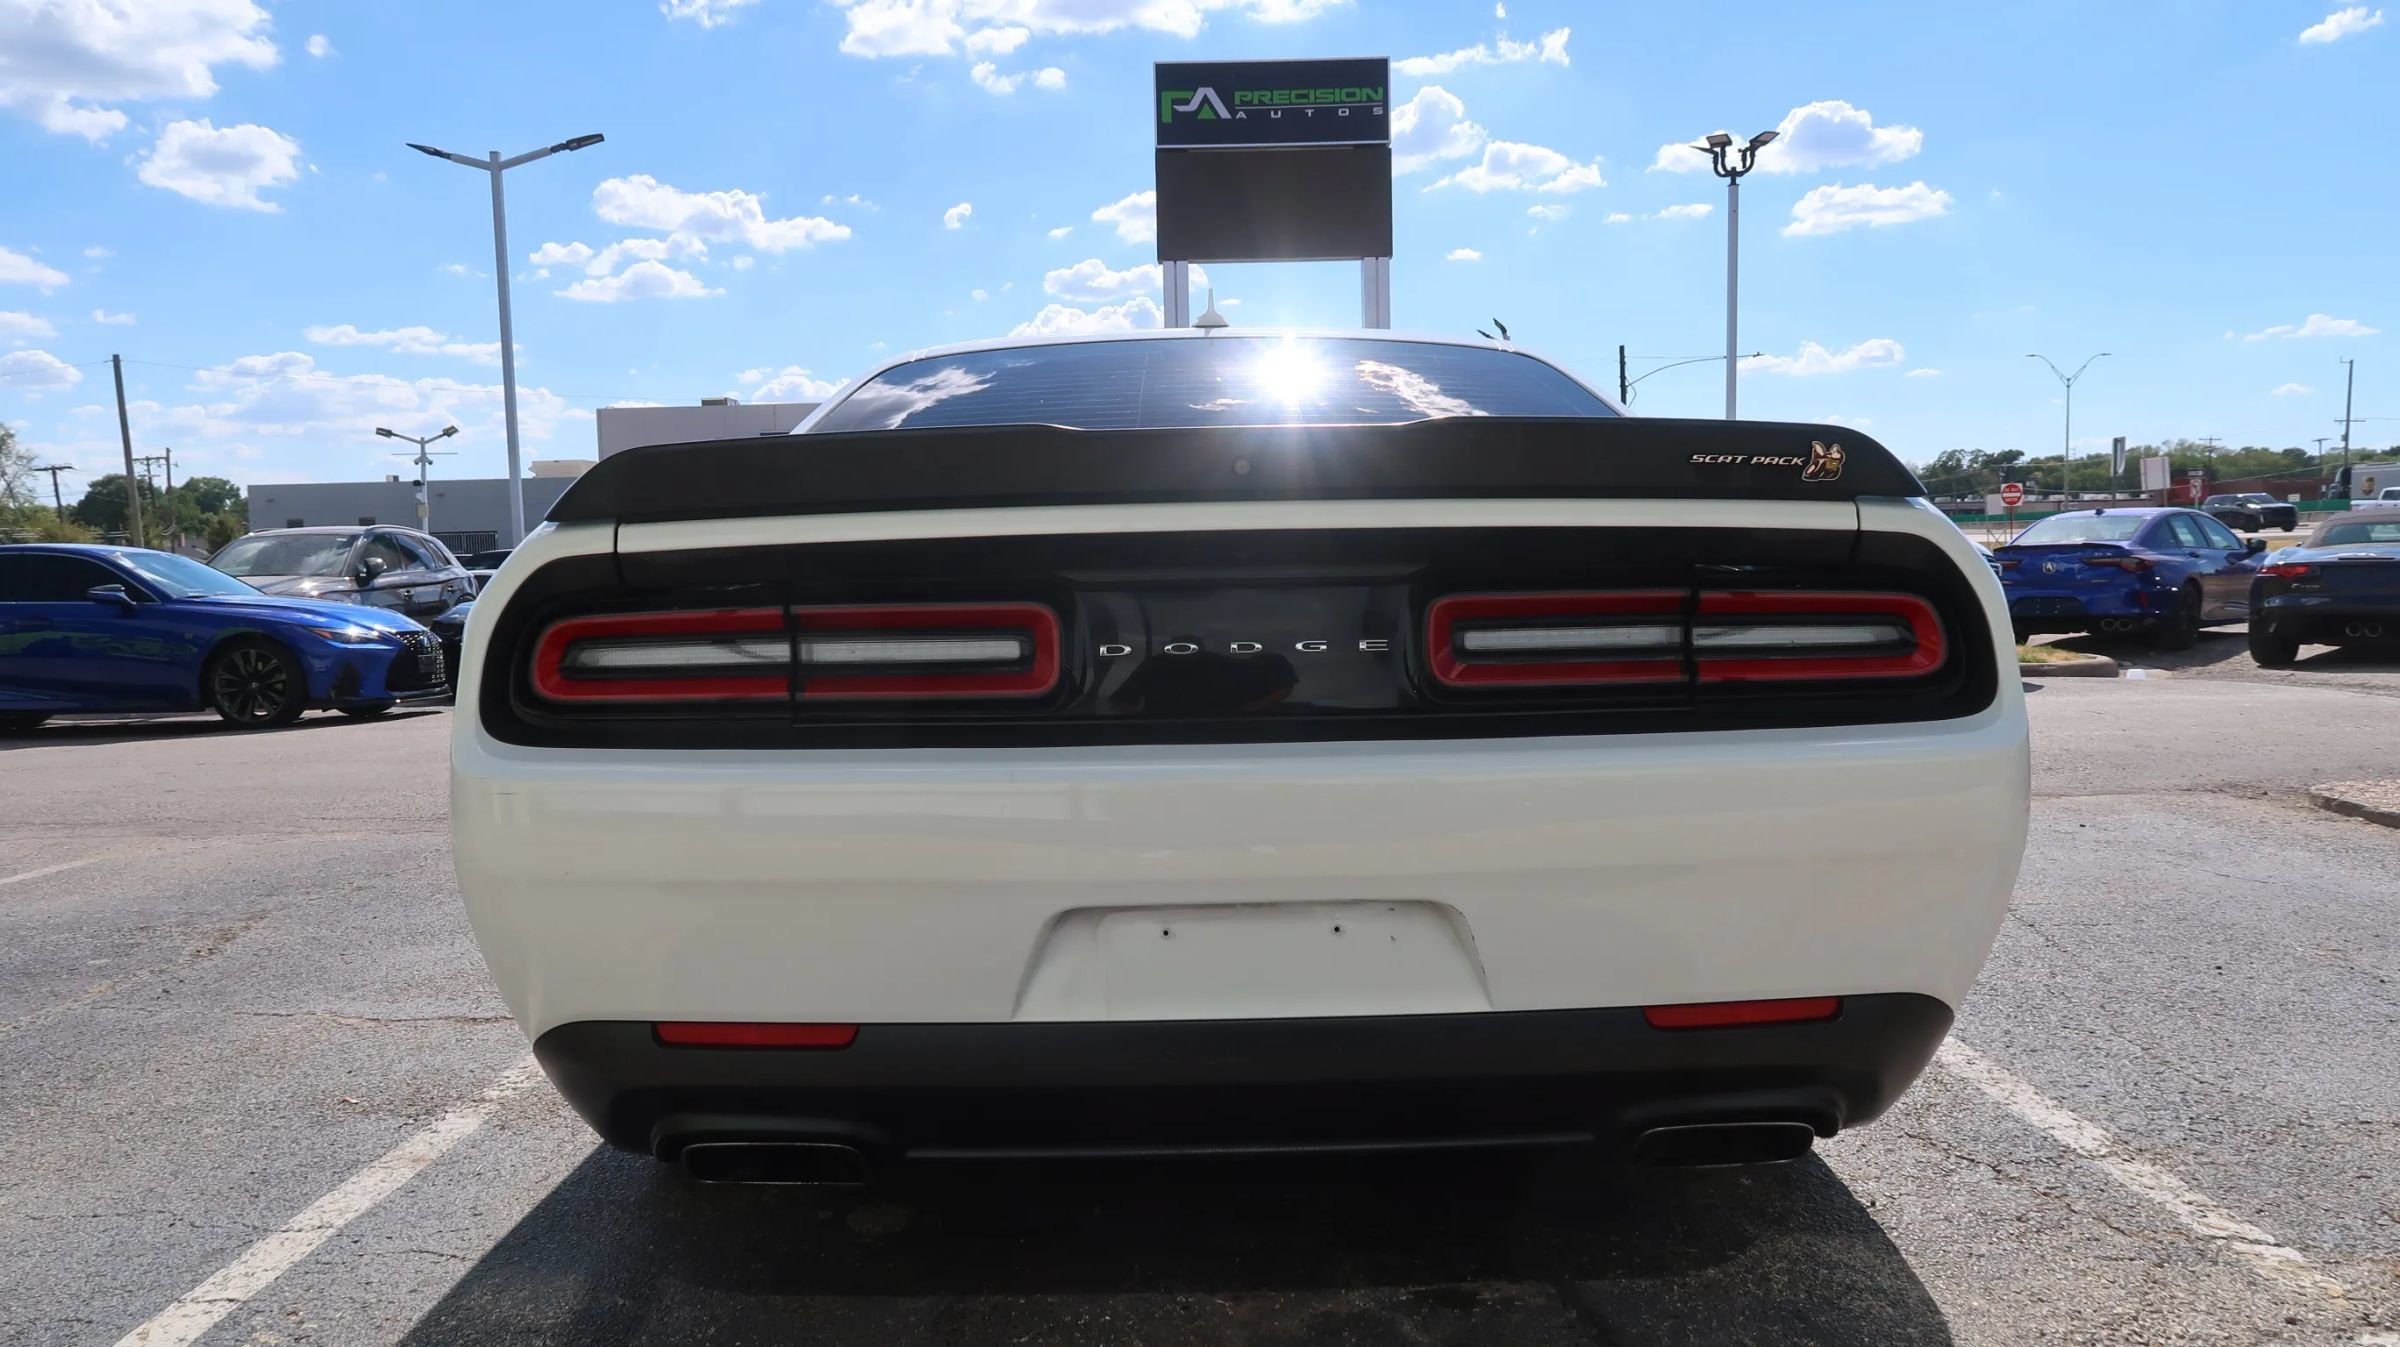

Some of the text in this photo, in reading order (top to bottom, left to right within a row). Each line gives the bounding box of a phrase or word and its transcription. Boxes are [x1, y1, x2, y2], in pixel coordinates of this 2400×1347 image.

[1234, 87, 1383, 105] PRECISION
[1236, 107, 1383, 119] AUTOS
[1690, 454, 1806, 466] SCAT PACK
[1099, 640, 1388, 657] DODGE
